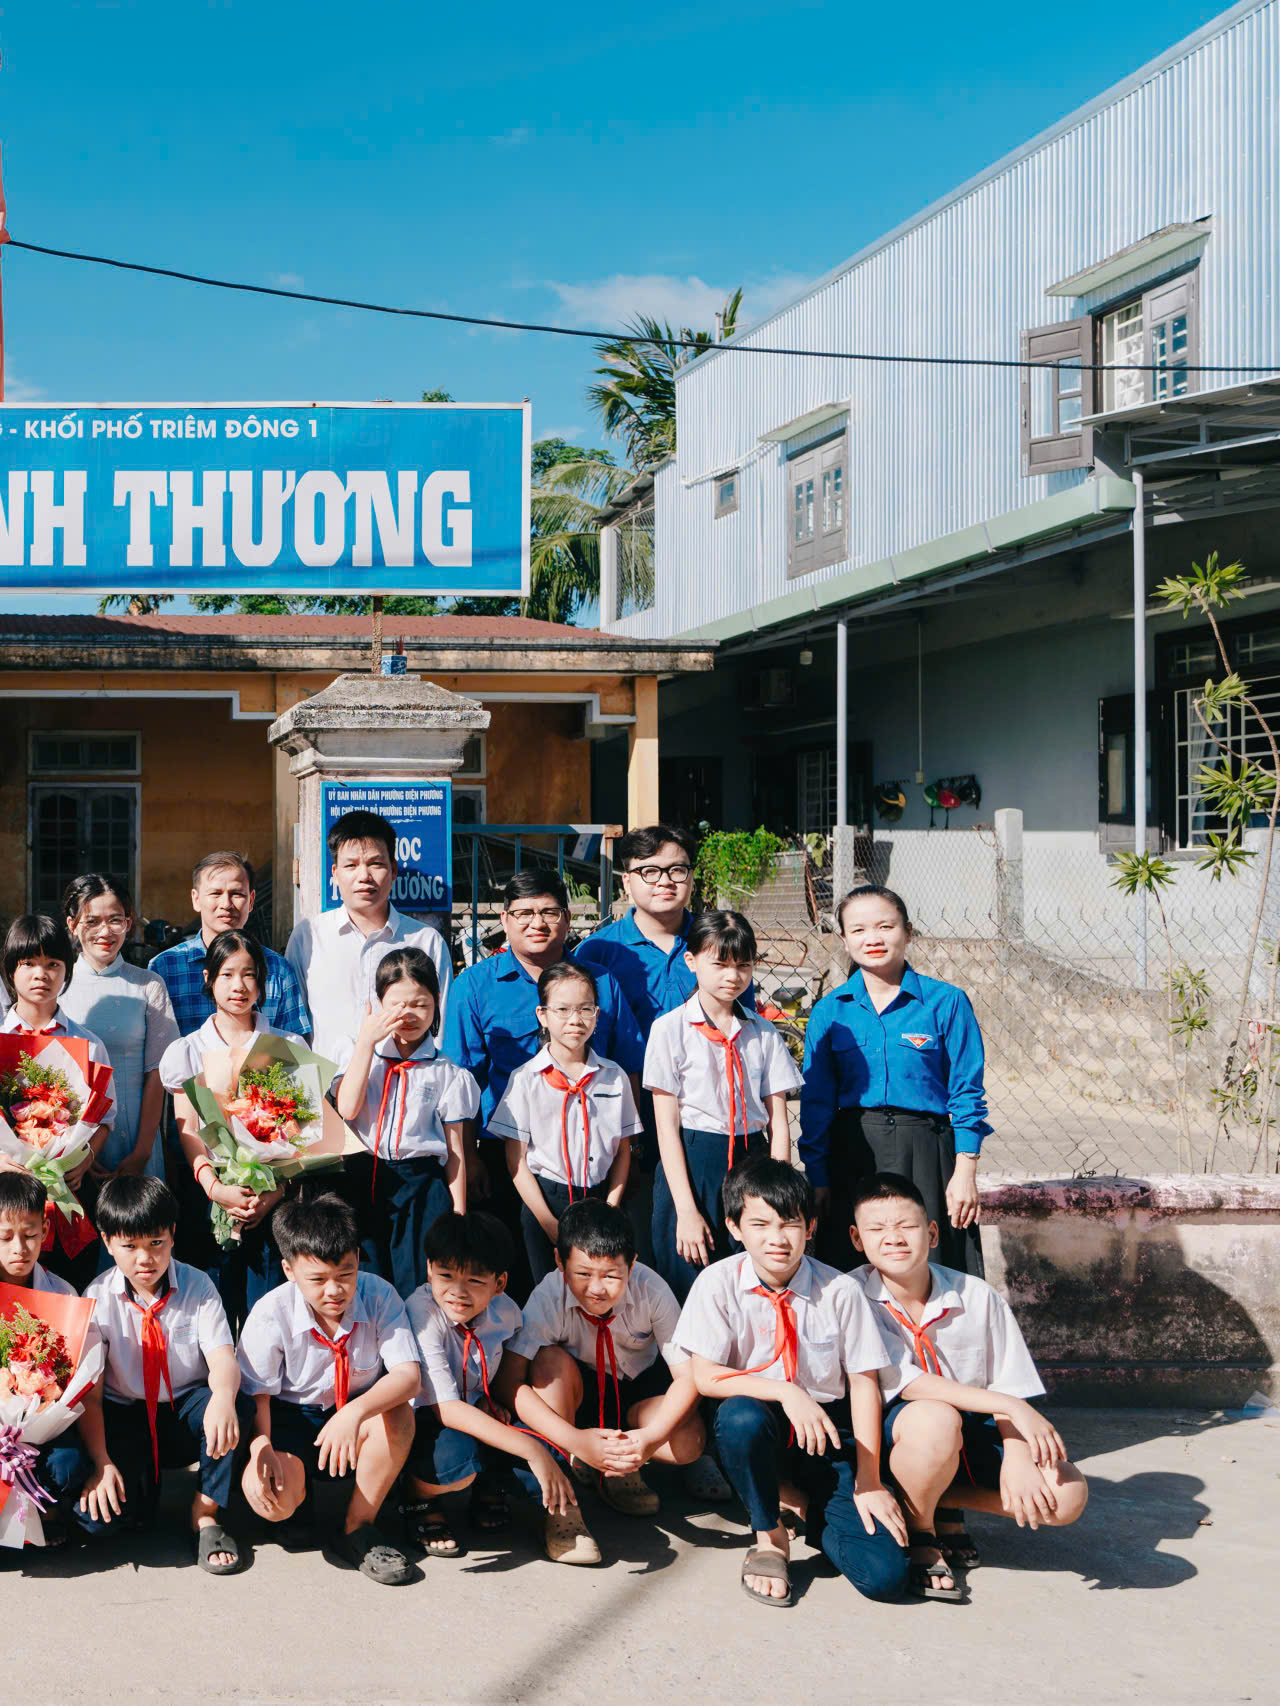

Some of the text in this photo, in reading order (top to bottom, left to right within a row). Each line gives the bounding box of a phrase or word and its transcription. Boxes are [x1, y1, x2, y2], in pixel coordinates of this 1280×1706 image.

[24, 411, 84, 439] KHỐI
[92, 411, 143, 439] PHỐ
[149, 414, 217, 439] TRIÊM
[224, 414, 300, 439] ĐÔNG
[308, 419, 317, 438] 1
[113, 470, 473, 567] THƯƠNG
[337, 791, 349, 801] BAN
